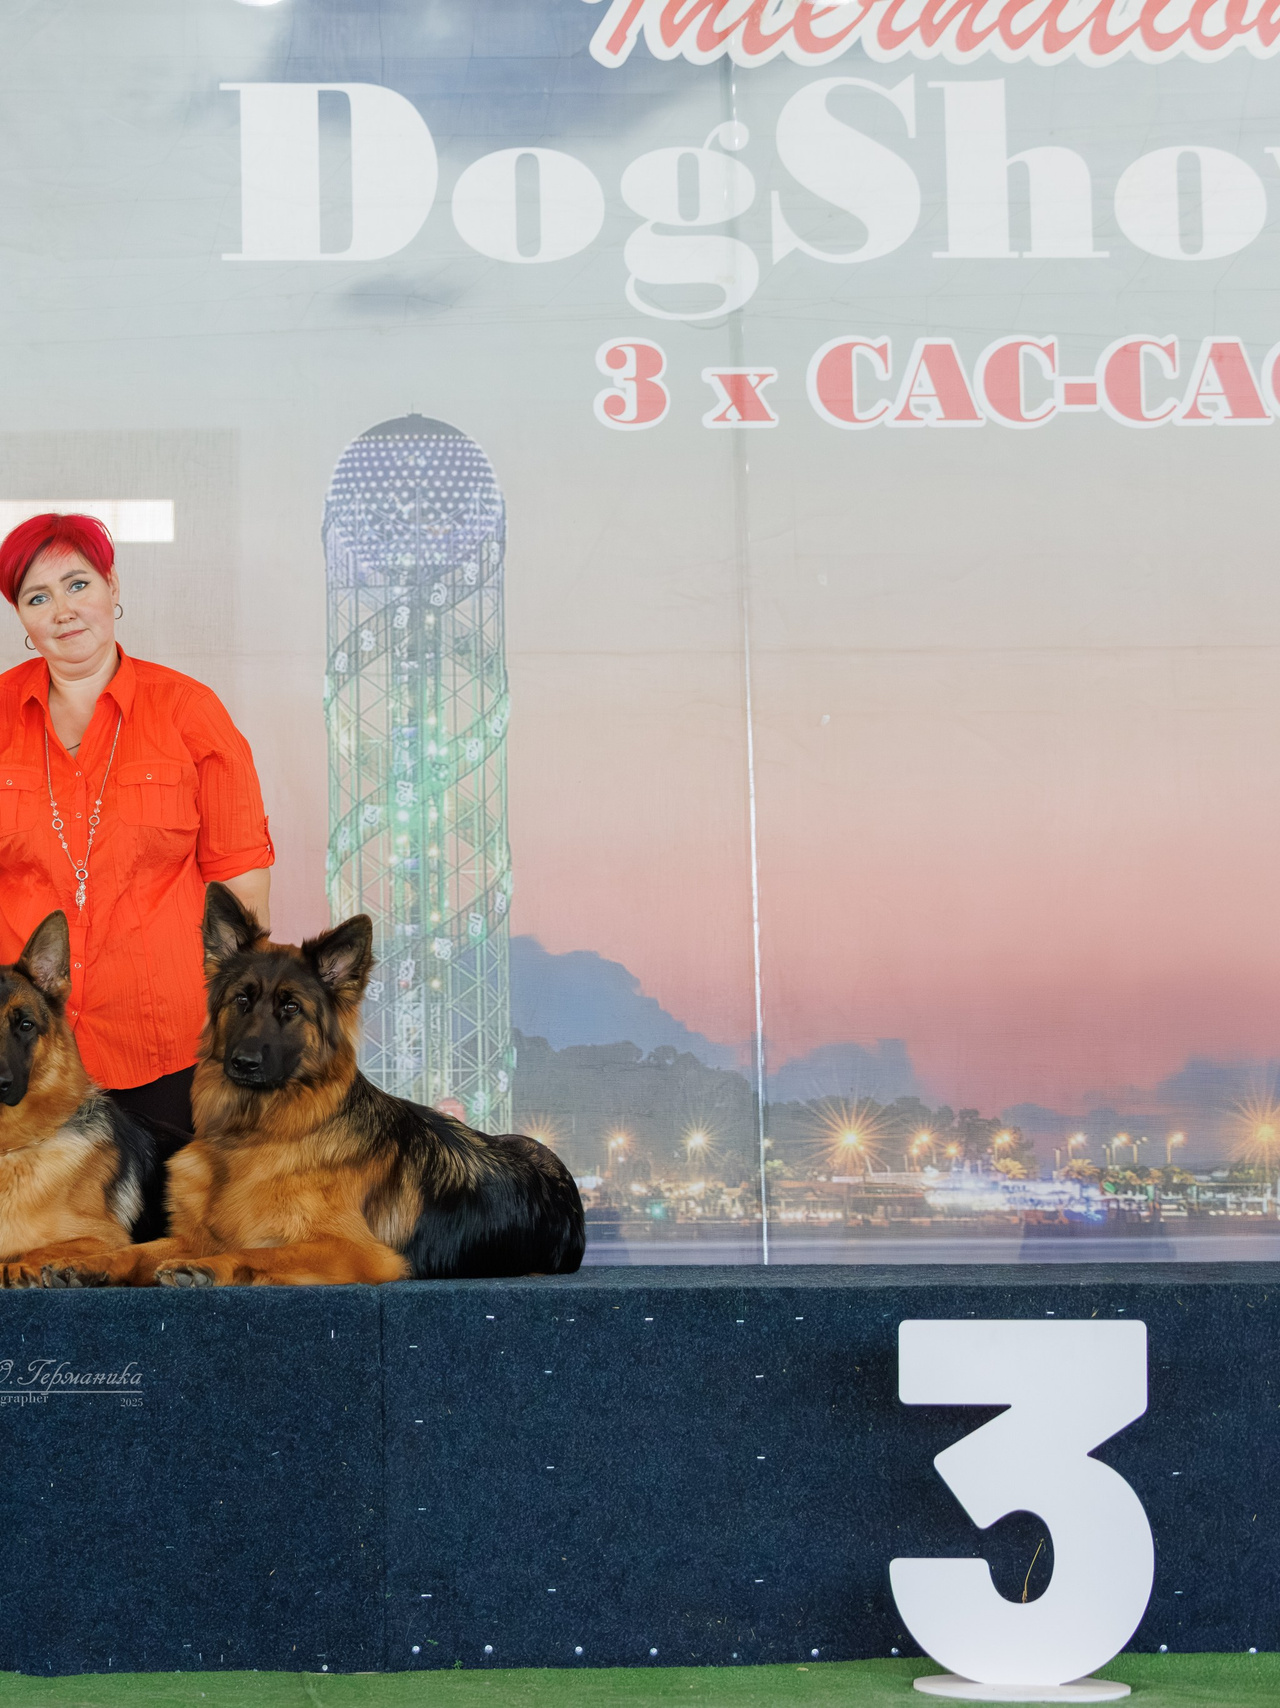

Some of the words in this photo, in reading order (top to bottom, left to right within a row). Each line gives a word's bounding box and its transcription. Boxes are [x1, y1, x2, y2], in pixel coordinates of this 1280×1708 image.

[219, 74, 1280, 321] DogSho
[595, 336, 670, 429] 3
[702, 365, 778, 429] x
[807, 334, 1280, 429] CAC-CA
[889, 1319, 1155, 1686] 3
